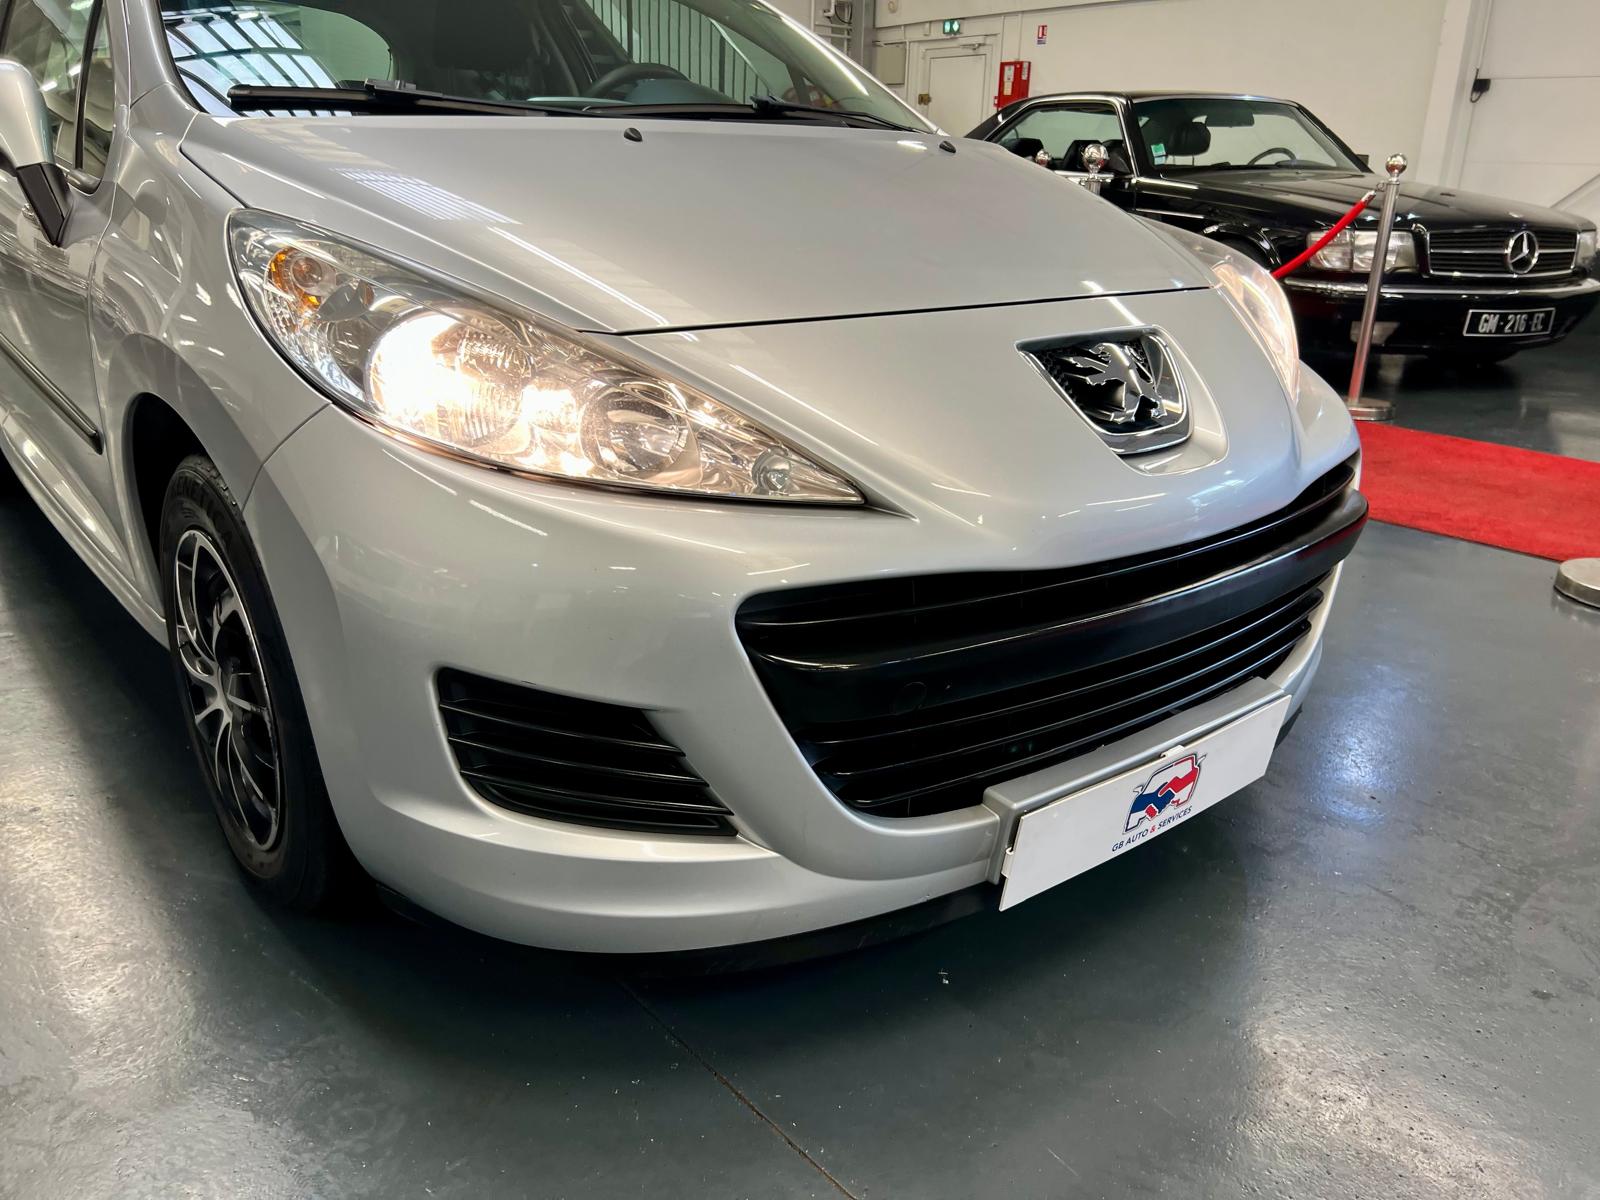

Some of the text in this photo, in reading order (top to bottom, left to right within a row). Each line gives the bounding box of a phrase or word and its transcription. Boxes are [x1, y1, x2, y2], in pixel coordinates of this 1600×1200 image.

[1111, 806, 1192, 852] GB AUTO & SERVICES
